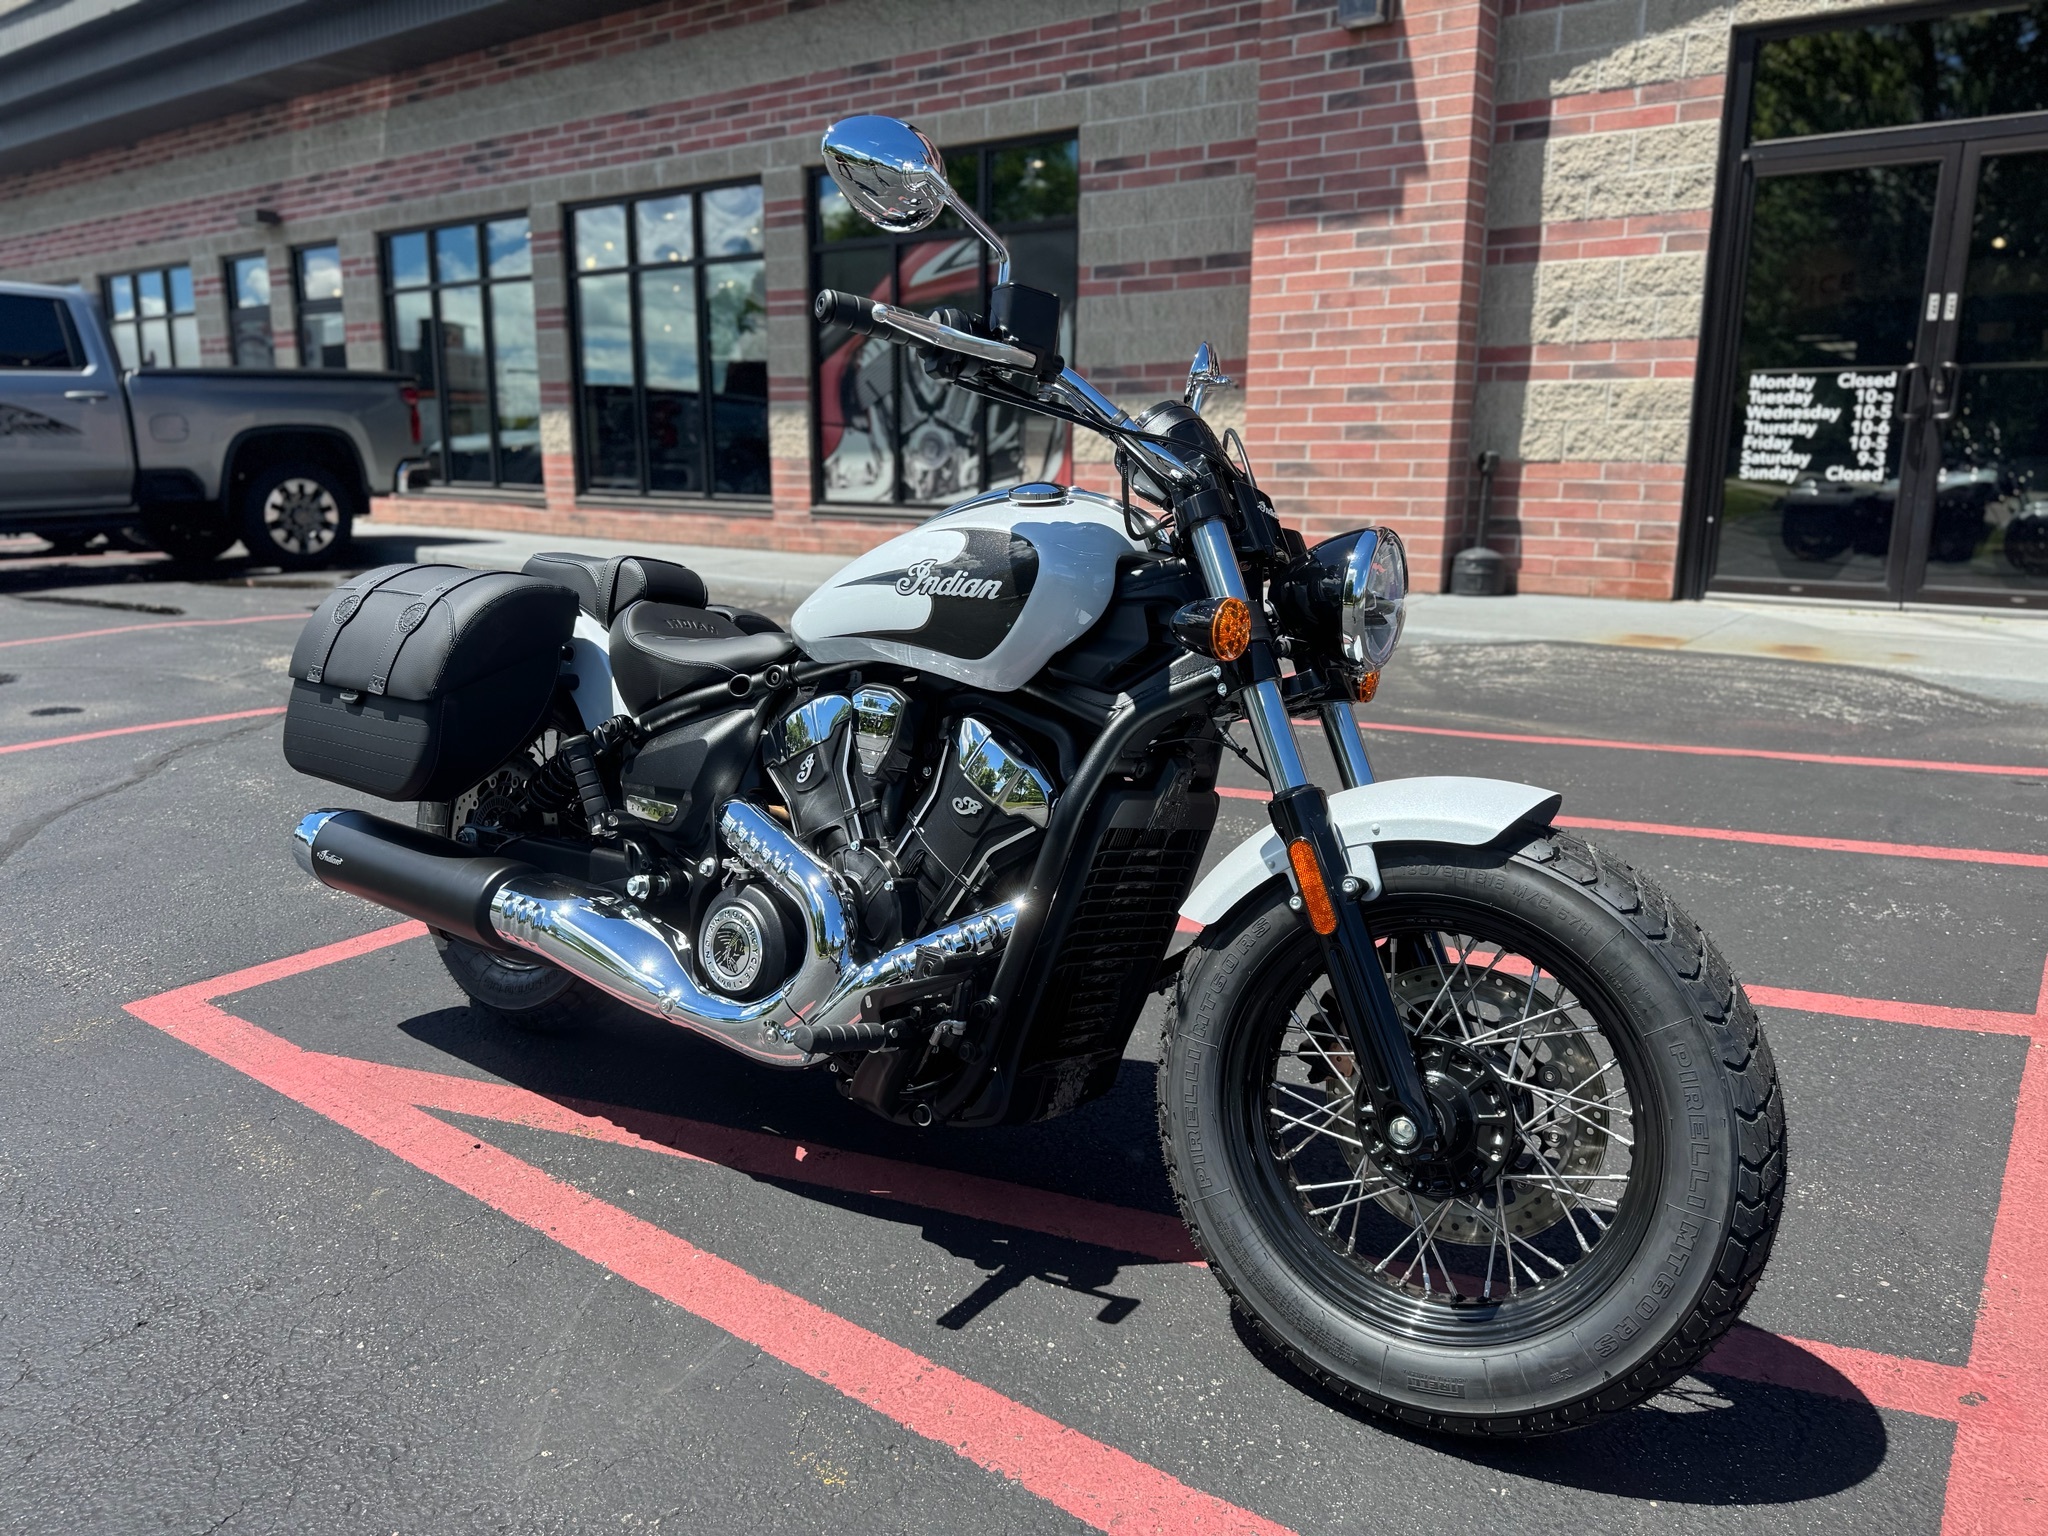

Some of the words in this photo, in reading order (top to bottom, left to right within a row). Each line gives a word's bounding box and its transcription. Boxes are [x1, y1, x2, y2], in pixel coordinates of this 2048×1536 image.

[1749, 373, 1817, 392] Monday
[1837, 371, 1898, 389] Closed
[1748, 390, 1814, 407] Tuesday
[1746, 403, 1842, 424] Wednesday
[1853, 404, 1892, 420] 10-5
[1744, 420, 1818, 439] Thursday
[1851, 420, 1890, 435] 10-6
[1742, 435, 1794, 453] Friday
[1849, 435, 1888, 451] 10-5
[1740, 450, 1812, 469] Saturday
[1739, 465, 1799, 484] Sunday
[1825, 465, 1884, 482] Closed
[894, 558, 1004, 601] Indian
[316, 850, 344, 866] Indian
[1184, 1042, 1214, 1189] PIRELLI
[1668, 1042, 1710, 1210] PIRELLI
